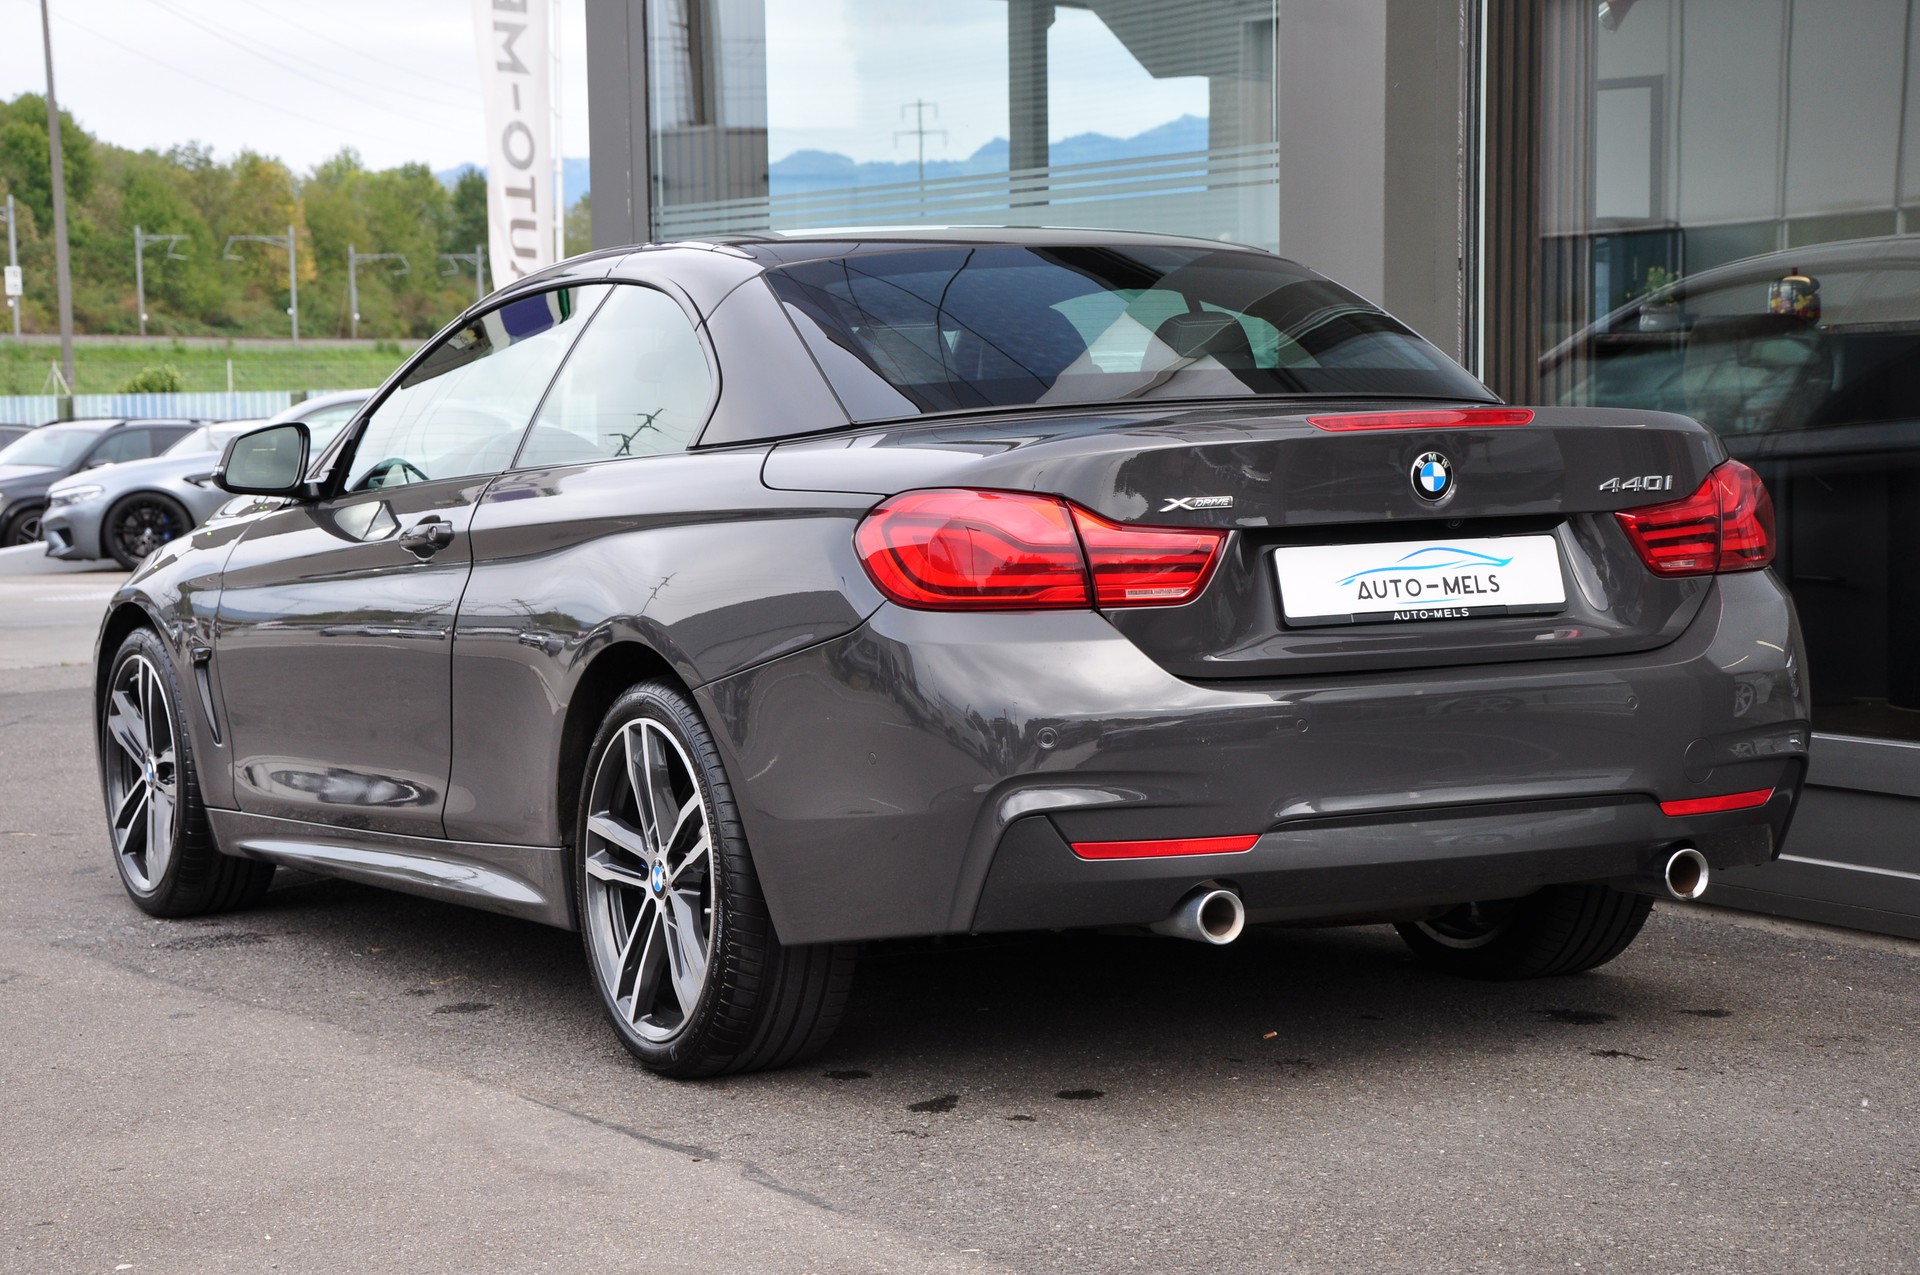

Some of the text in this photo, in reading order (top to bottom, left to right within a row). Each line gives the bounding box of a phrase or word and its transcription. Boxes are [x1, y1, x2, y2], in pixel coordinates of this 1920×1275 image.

[1414, 452, 1450, 470] BMW
[1357, 574, 1500, 600] AUTO-MELS
[1393, 608, 1470, 621] AUTO-MELS
